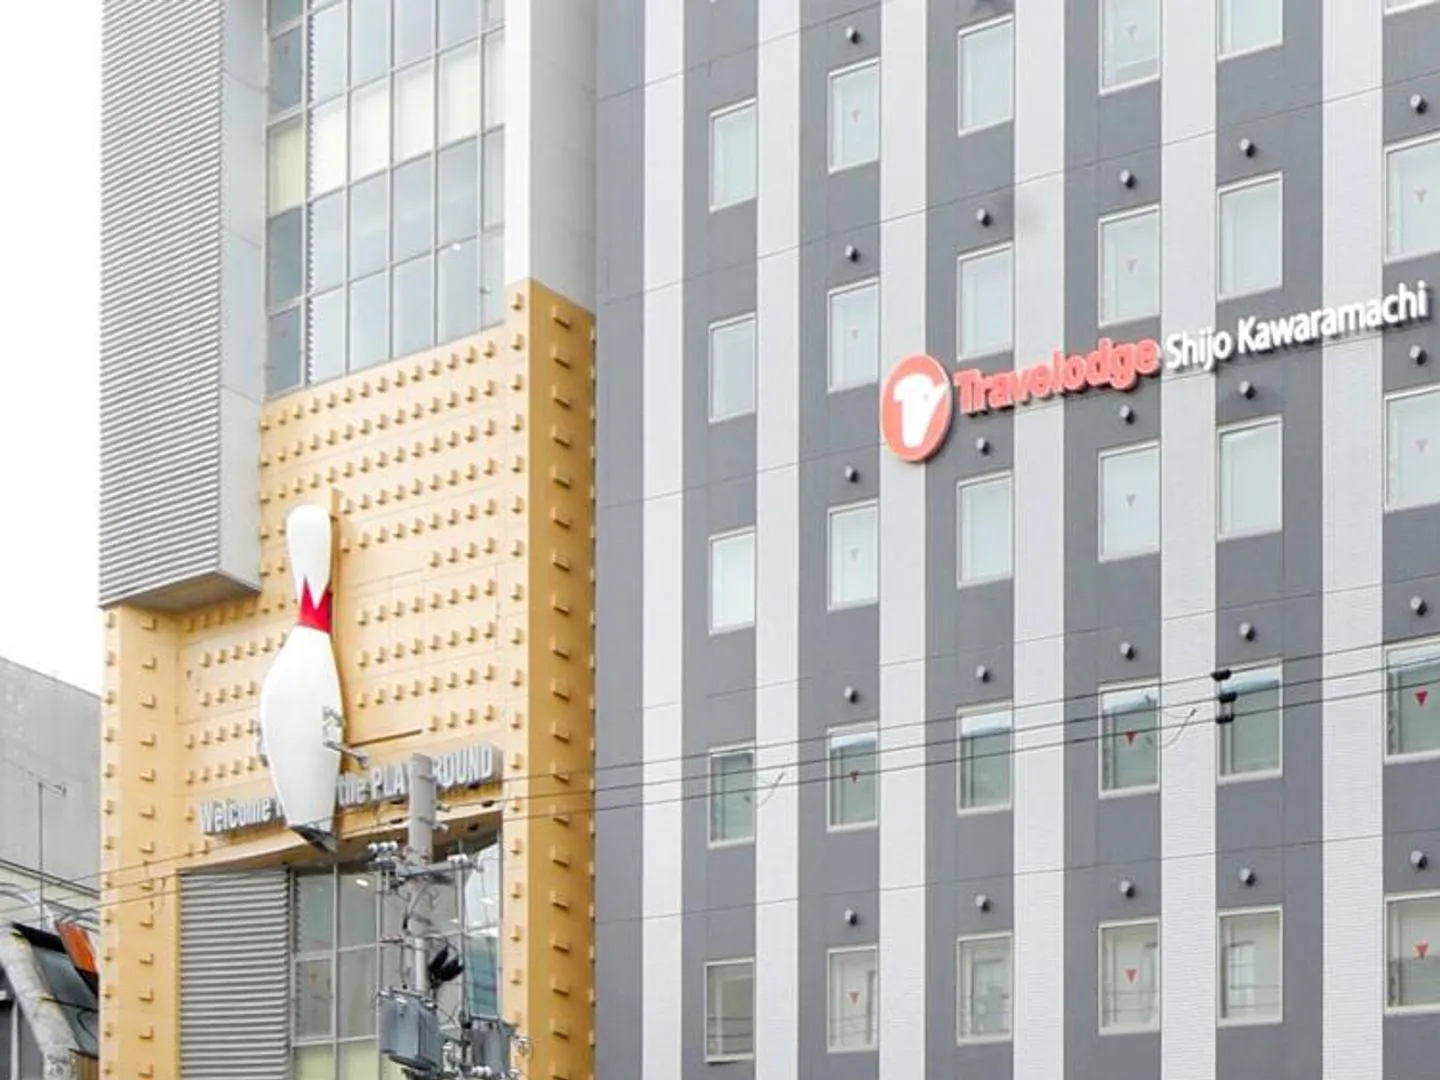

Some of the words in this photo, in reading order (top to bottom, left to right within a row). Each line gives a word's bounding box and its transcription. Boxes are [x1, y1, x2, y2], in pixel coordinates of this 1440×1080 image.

[955, 338, 1161, 413] Travelodge
[1166, 327, 1232, 371] Shijo
[1238, 281, 1428, 354] Kawaramachi
[200, 798, 272, 833] Welcome
